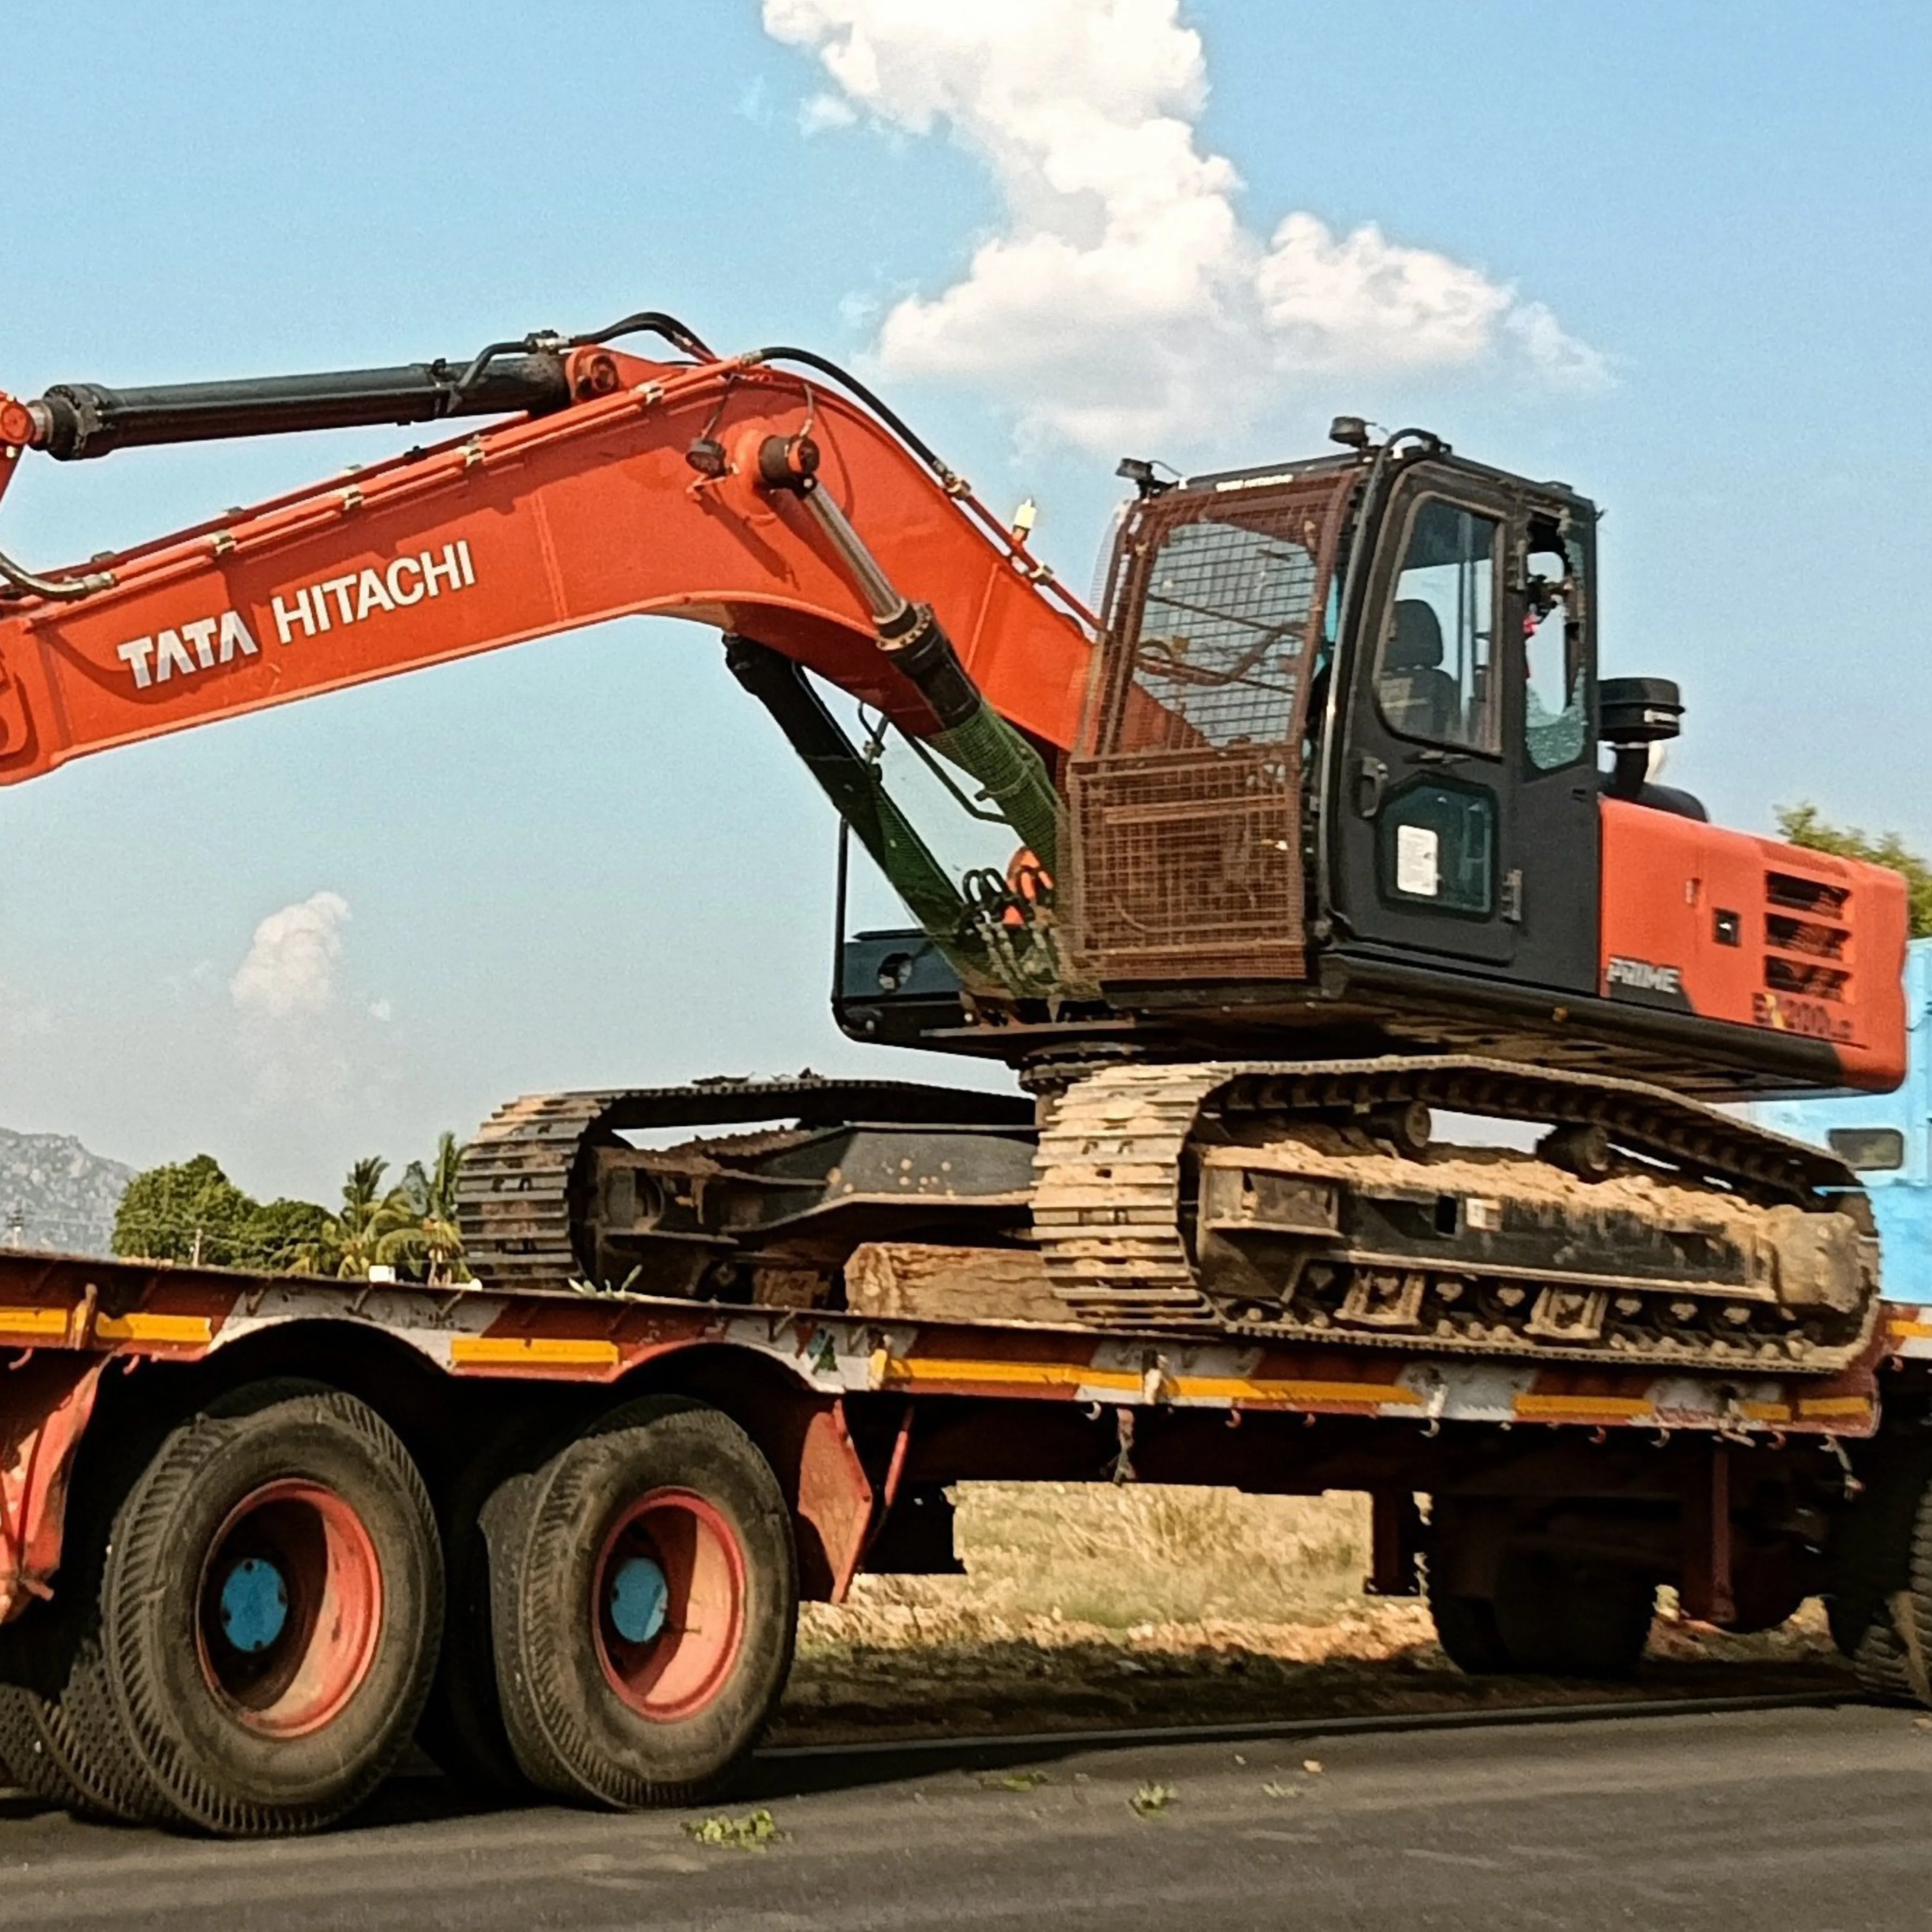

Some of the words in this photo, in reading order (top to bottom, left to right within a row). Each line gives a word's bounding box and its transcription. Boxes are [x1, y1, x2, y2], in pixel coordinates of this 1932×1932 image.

[117, 611, 258, 689] TATA
[272, 540, 475, 644] HITACHI
[1606, 958, 1679, 994] PRIME
